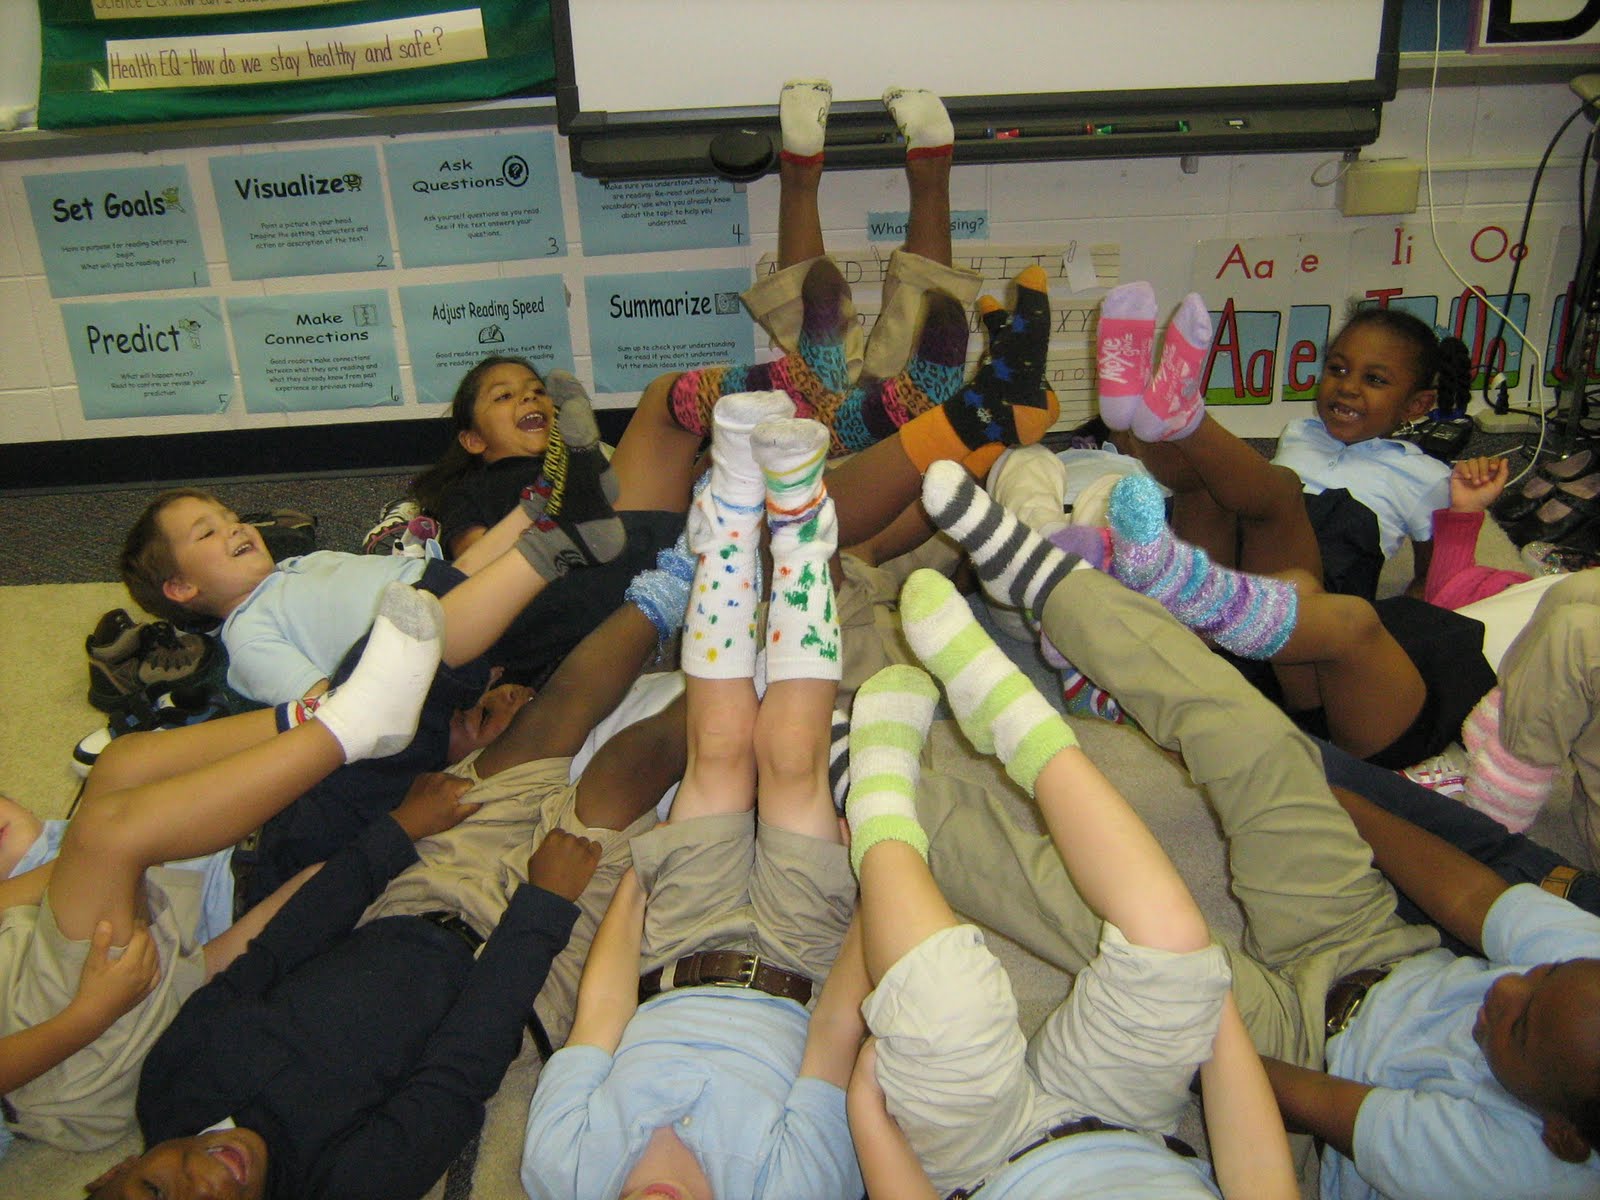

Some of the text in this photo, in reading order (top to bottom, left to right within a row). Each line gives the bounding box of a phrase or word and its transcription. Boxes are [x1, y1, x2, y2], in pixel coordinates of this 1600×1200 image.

[109, 52, 159, 80] Health
[219, 47, 236, 74] do
[241, 57, 263, 74] we
[270, 45, 300, 77] stay
[305, 41, 357, 71] healthy
[365, 34, 393, 63] and
[399, 26, 444, 59] safe?
[439, 159, 473, 172] Ask
[234, 173, 345, 201] Visualize
[412, 176, 504, 194] Questions
[641, 181, 653, 190] you
[655, 178, 694, 187] understand
[53, 190, 166, 223] Set Goals
[643, 209, 655, 217] the
[701, 206, 713, 216] you
[673, 199, 686, 207] you
[510, 209, 522, 218] you
[732, 223, 745, 244] 4
[871, 216, 985, 235] What sing?
[545, 237, 560, 255] 3
[1215, 226, 1529, 280] Aa e Ii Oo
[376, 254, 388, 267] 2
[845, 260, 863, 284] D
[432, 296, 545, 325] Adjust Reading Speed
[609, 291, 712, 319] Summarize
[296, 312, 344, 326] Make
[1057, 308, 1094, 332] X Y
[86, 322, 180, 355] Predict
[264, 331, 369, 345] Connections
[672, 343, 687, 351] your
[435, 351, 452, 359] Good
[453, 350, 479, 358] readers
[508, 345, 519, 353] the
[521, 344, 536, 352] text
[537, 344, 554, 352] they
[1200, 298, 1273, 398] Aa
[686, 360, 701, 369] your
[390, 384, 400, 402] 6
